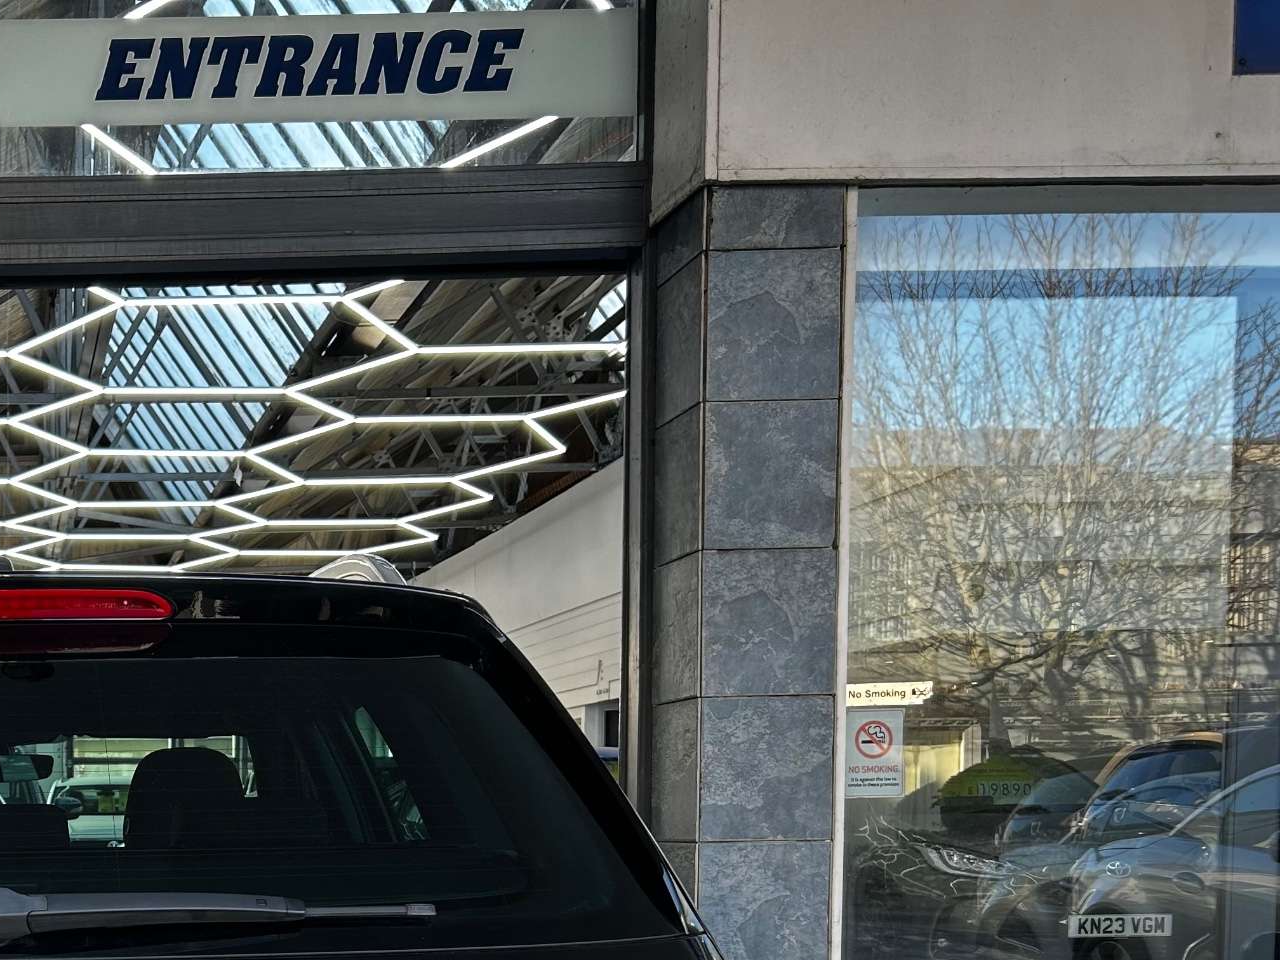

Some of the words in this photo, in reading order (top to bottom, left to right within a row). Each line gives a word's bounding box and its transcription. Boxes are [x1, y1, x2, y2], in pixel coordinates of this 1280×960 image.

[95, 28, 524, 102] ENTRANCE
[848, 690, 862, 699] No
[865, 688, 906, 700] Smoking
[848, 765, 861, 774] NO
[862, 764, 898, 774] SMOKING
[1078, 917, 1126, 935] KN23
[1132, 916, 1165, 934] VGM
